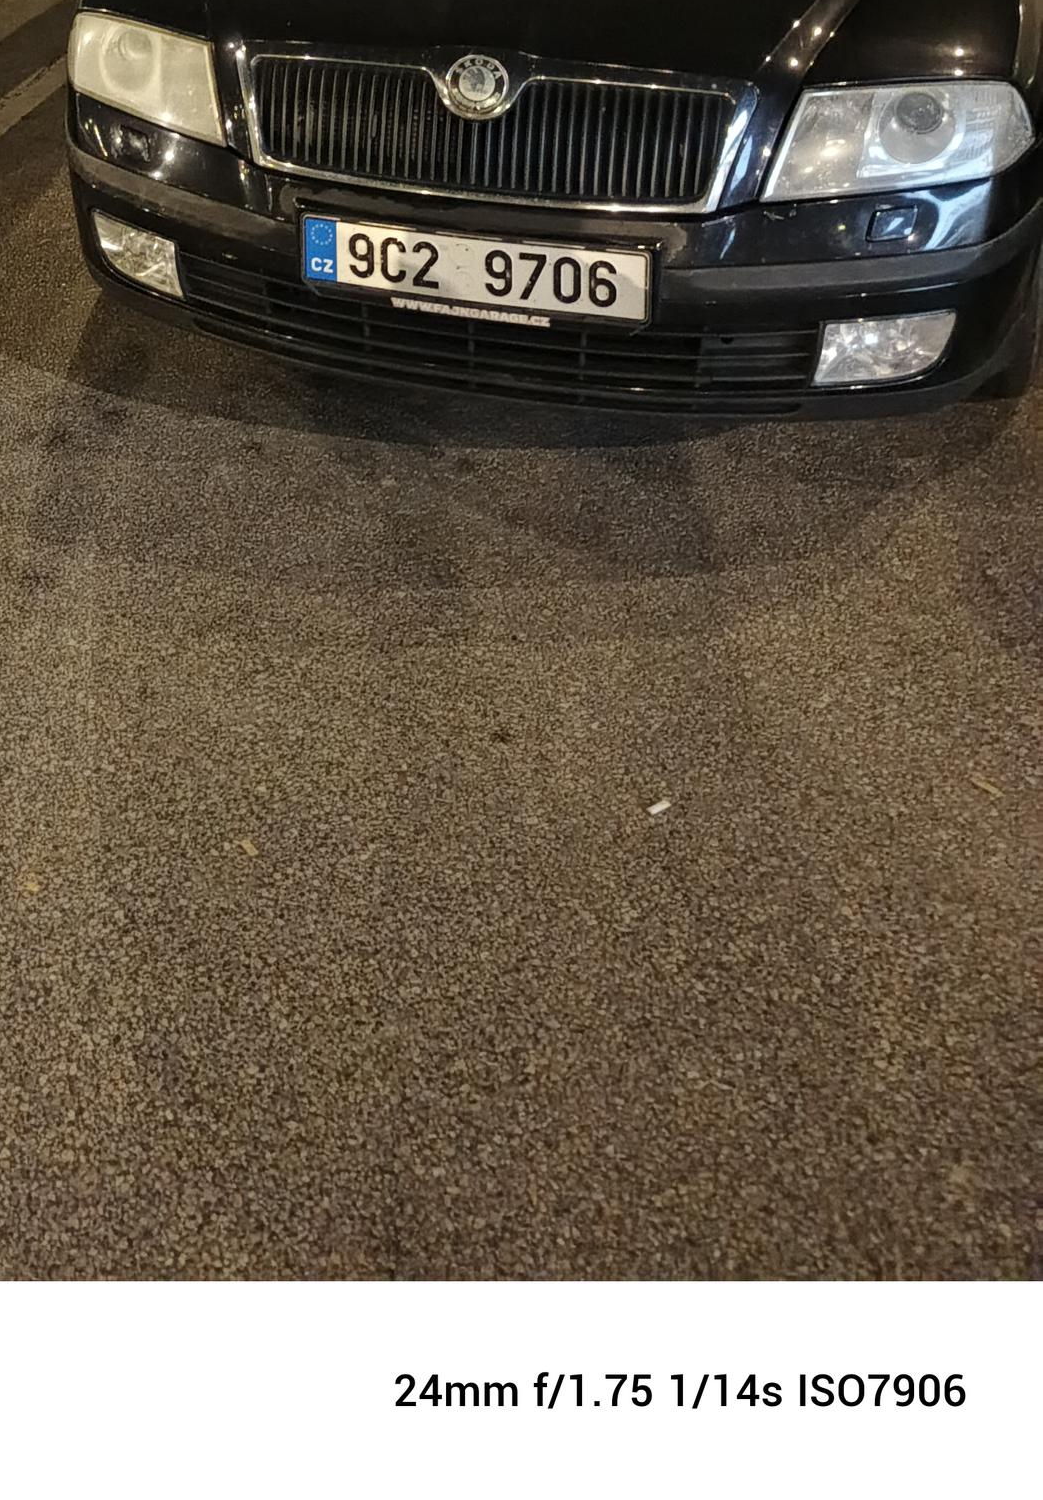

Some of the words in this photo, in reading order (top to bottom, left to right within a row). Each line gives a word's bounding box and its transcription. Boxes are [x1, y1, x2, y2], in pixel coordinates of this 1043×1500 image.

[310, 256, 334, 274] CZ
[348, 232, 439, 290] 9C2
[484, 249, 618, 308] 9706
[390, 296, 551, 328] WWW.FAJNGARAGE.CZ
